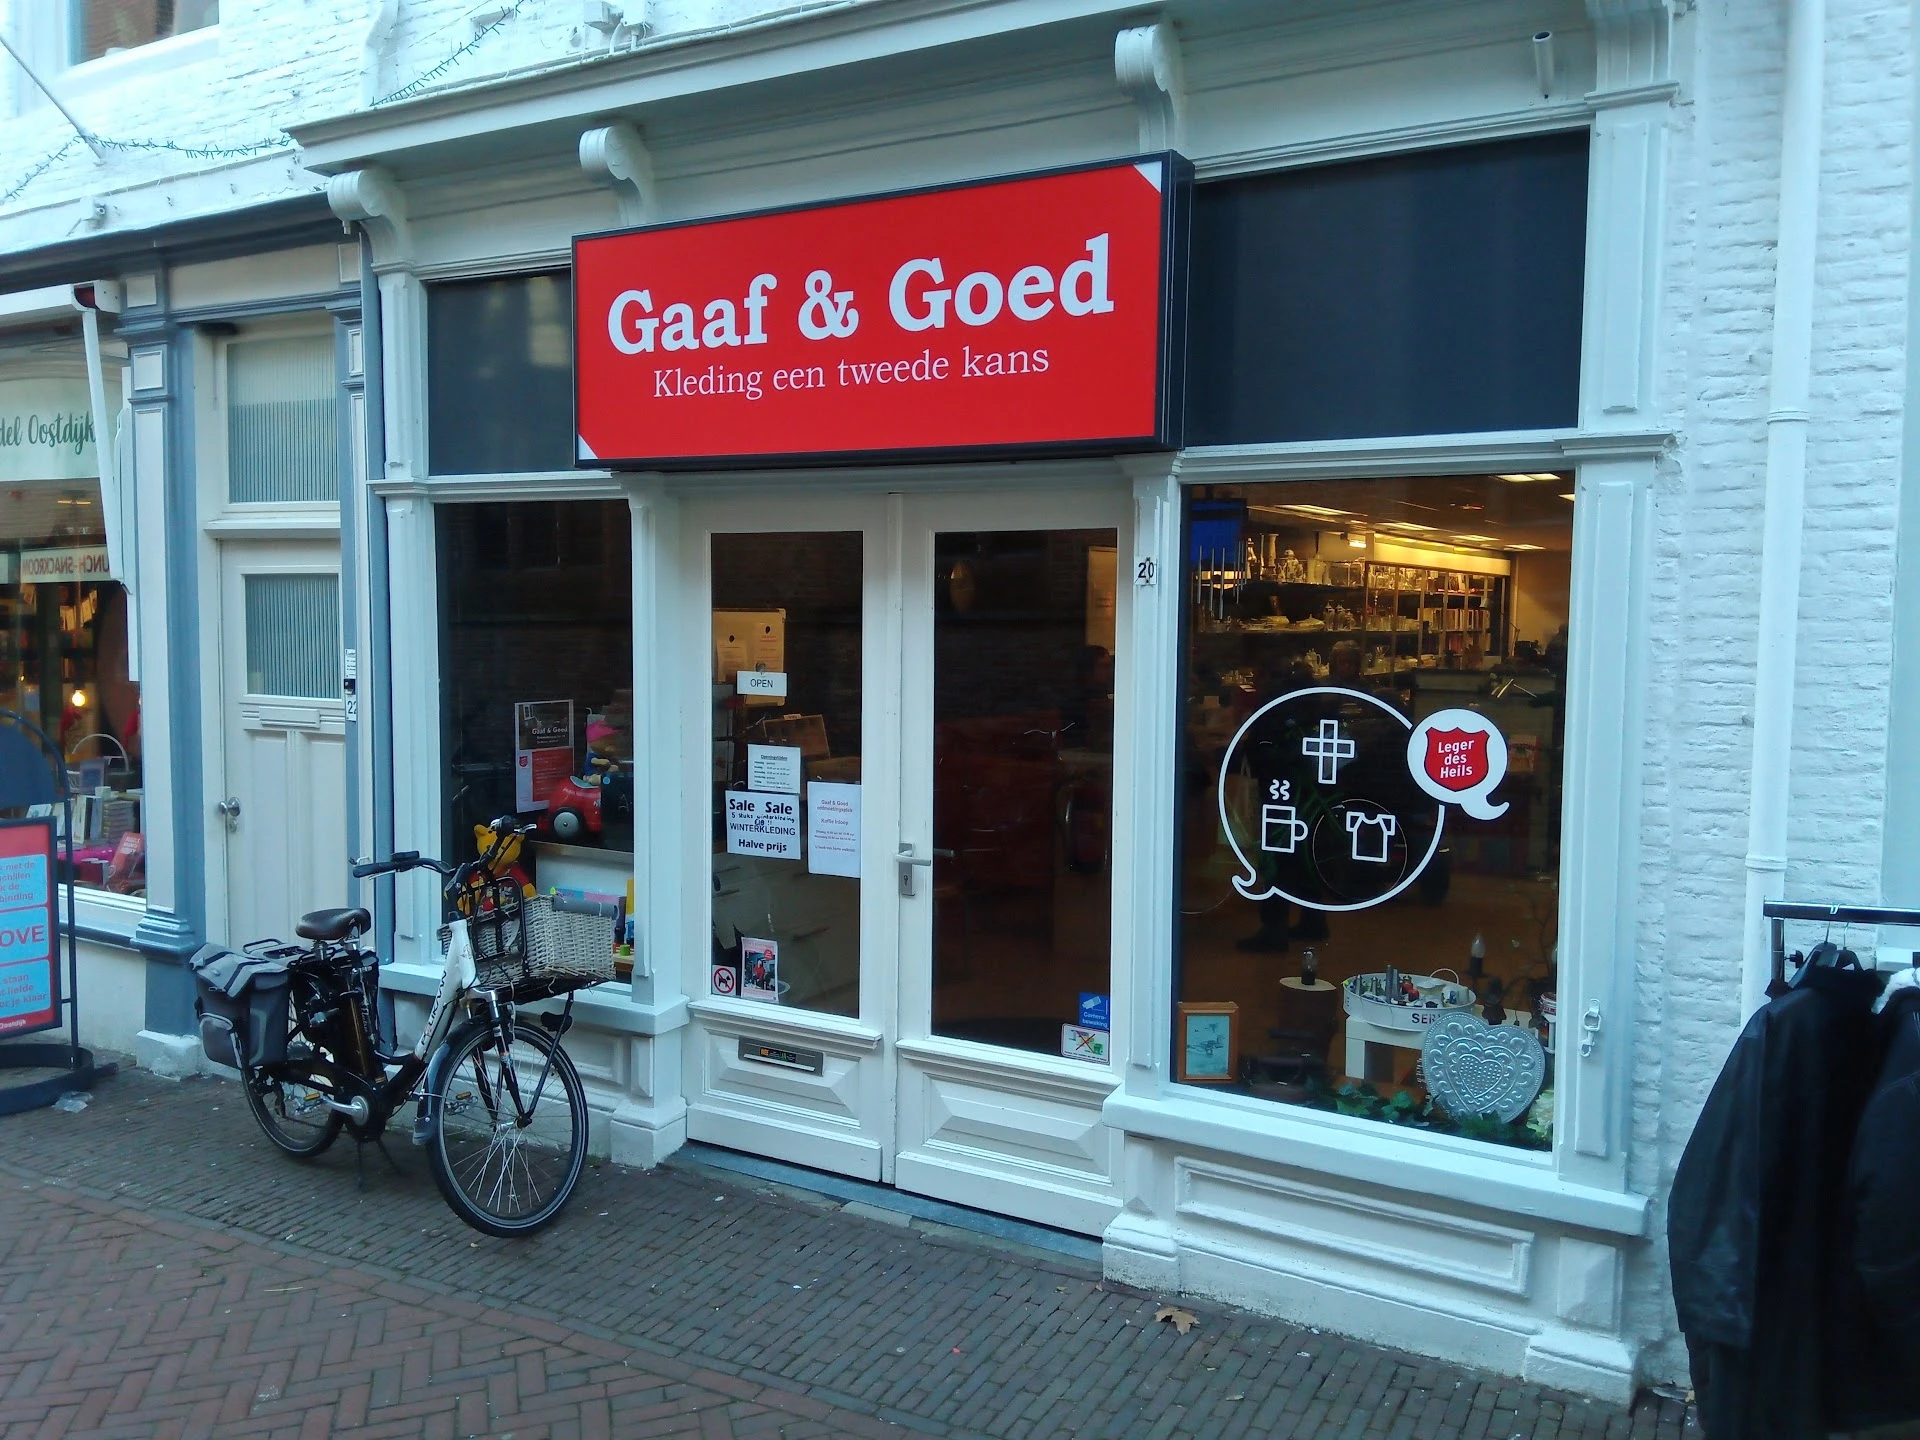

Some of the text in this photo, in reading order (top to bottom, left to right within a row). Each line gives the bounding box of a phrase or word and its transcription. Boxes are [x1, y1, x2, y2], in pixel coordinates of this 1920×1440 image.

[607, 232, 1114, 355] Gaaf & Goed
[653, 344, 1049, 400] Kleding een tweede kans
[28, 411, 96, 455] Oostdijk
[1138, 562, 1155, 578] 20
[750, 678, 774, 688] OPEN
[1438, 740, 1475, 755] Leger
[1444, 753, 1468, 766] des
[1440, 764, 1473, 779] Heils
[729, 798, 793, 815] Sale Sale
[729, 822, 796, 836] WINTERKLEDING
[738, 838, 787, 854] Halve prijs
